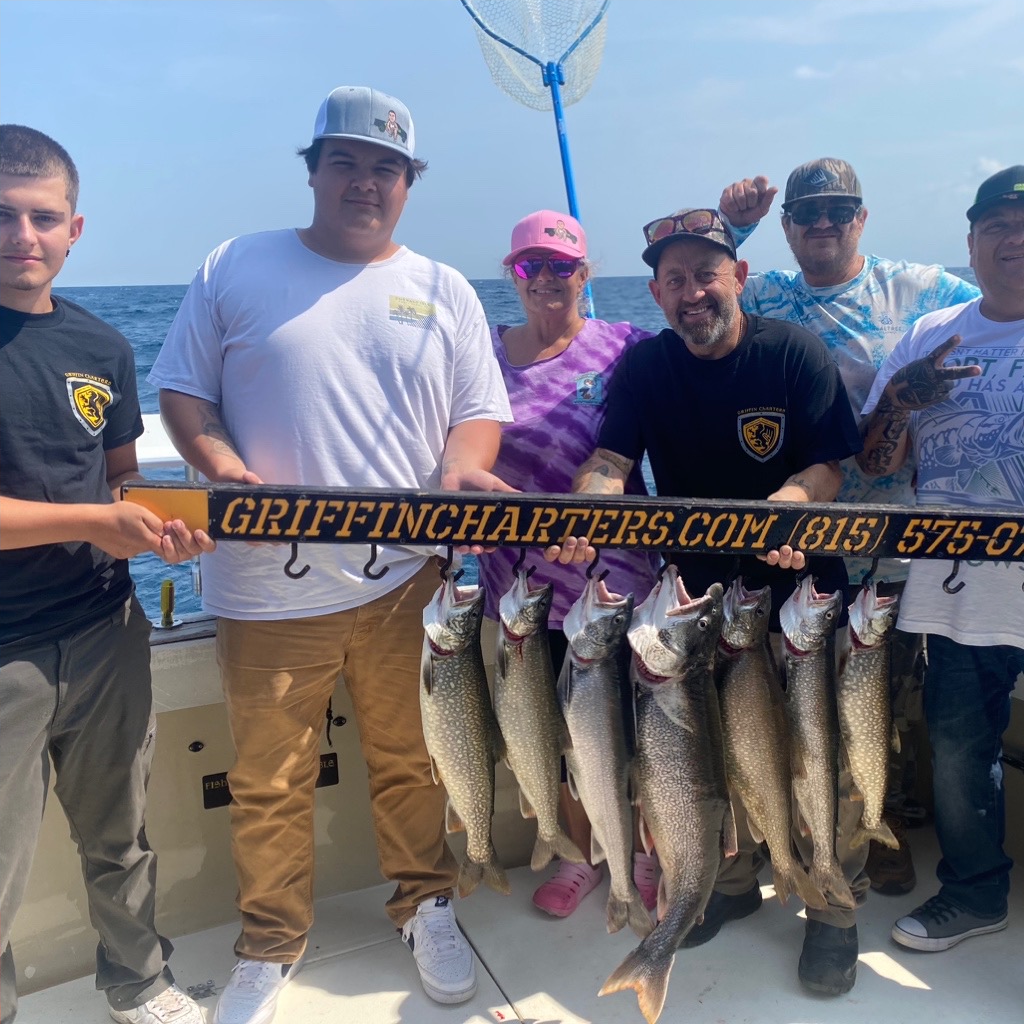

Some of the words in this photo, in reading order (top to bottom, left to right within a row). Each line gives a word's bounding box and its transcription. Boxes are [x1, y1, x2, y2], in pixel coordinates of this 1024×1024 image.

[973, 348, 1017, 357] MATTER
[220, 496, 779, 550] GRIFFINCHARTERS.COM
[786, 512, 890, 555] (815)
